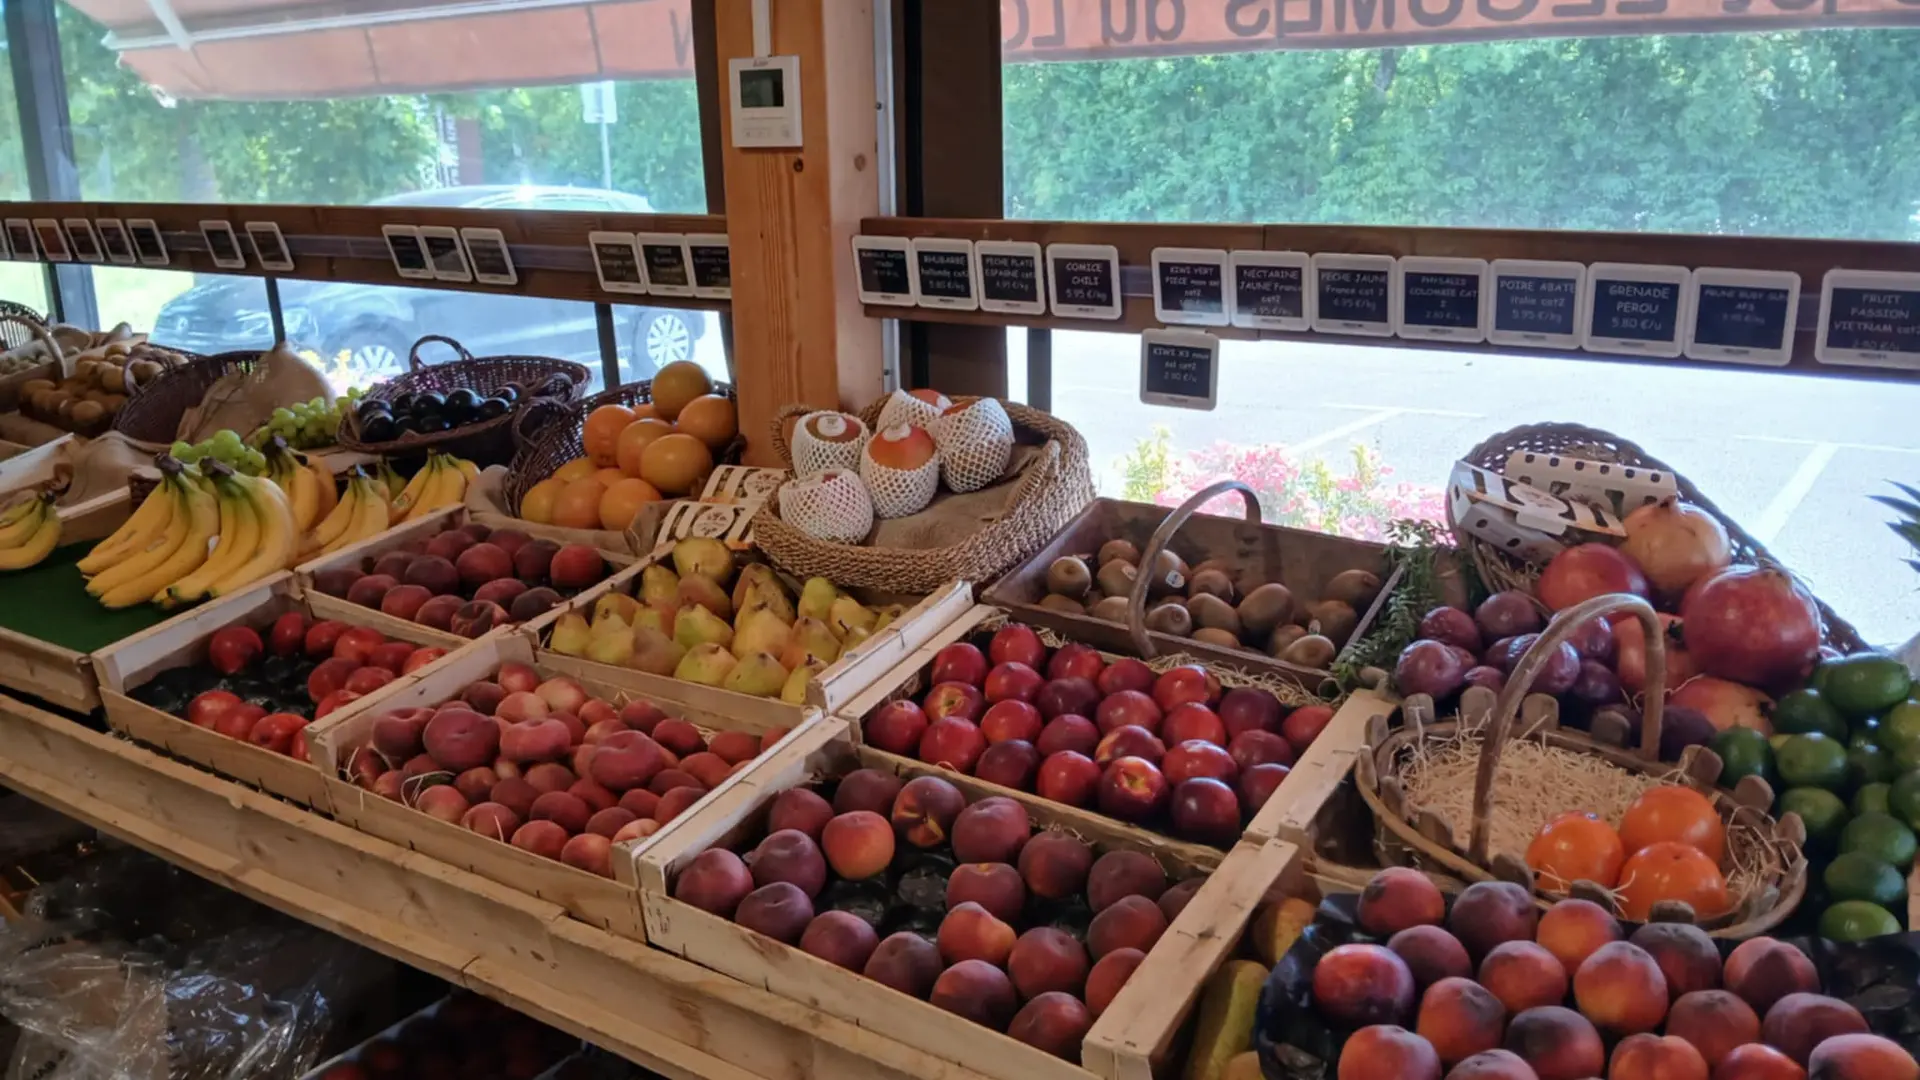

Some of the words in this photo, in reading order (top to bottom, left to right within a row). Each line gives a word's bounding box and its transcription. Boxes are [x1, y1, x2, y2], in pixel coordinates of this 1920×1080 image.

[1066, 262, 1103, 273] COMICE
[1243, 269, 1299, 280] NECTARINE
[1072, 276, 1101, 286] CHILI
[1239, 281, 1272, 291] JAUNE
[1500, 280, 1534, 292] POIRE
[1608, 284, 1671, 300] GRENADE
[1862, 293, 1902, 305] FRUIT
[1616, 301, 1660, 314] PEROU
[1850, 306, 1910, 320] PASSION
[1833, 320, 1893, 334] VIETNAM
